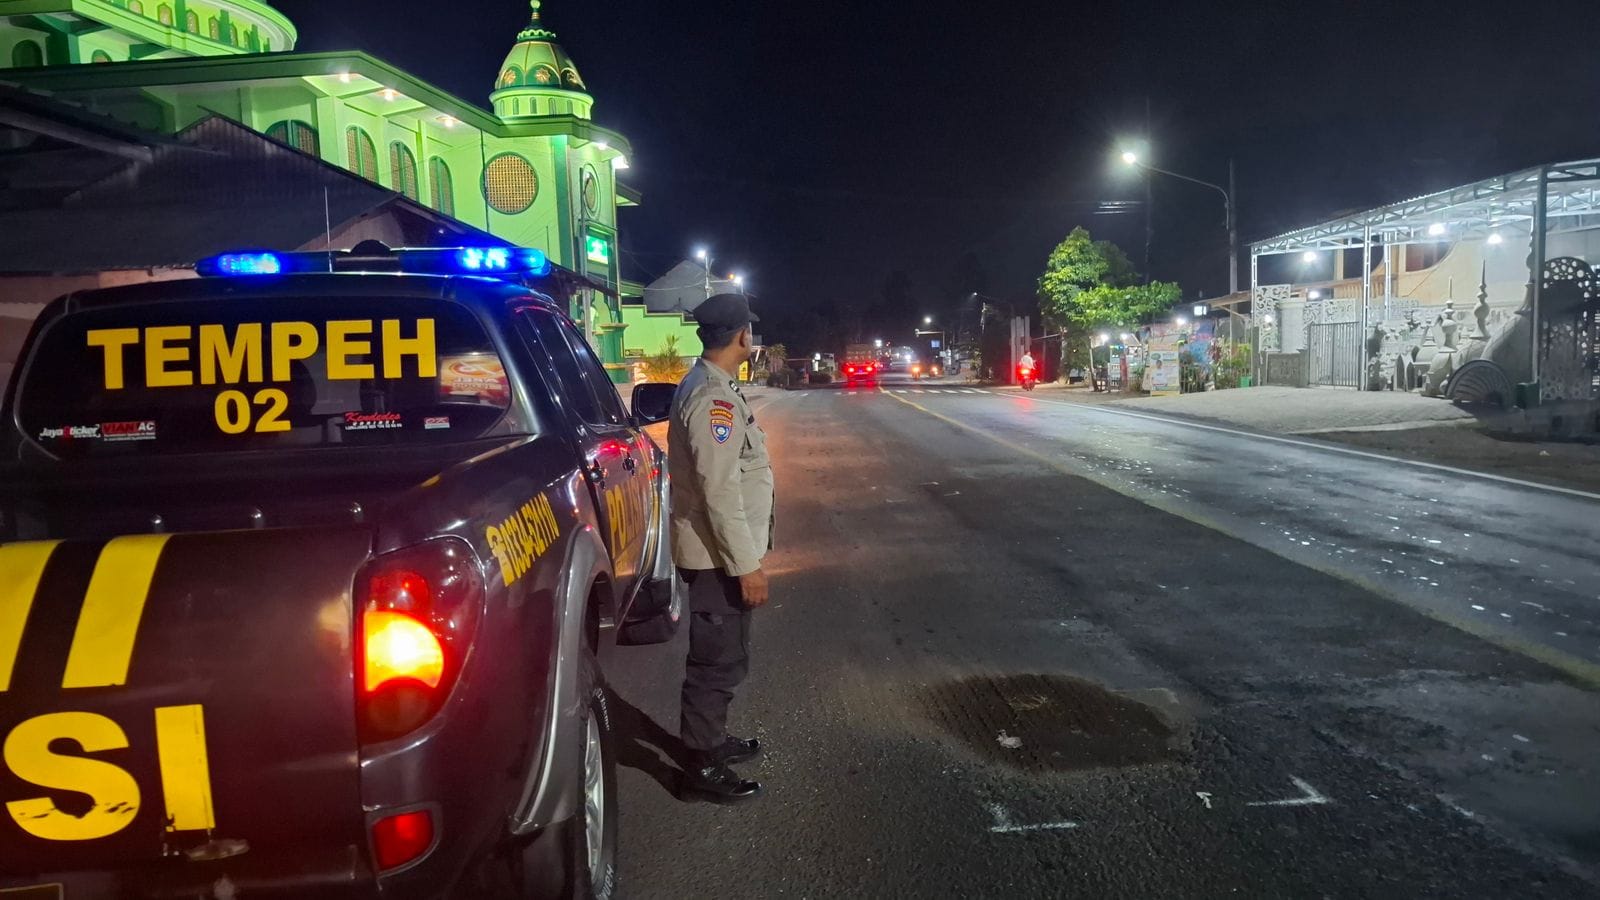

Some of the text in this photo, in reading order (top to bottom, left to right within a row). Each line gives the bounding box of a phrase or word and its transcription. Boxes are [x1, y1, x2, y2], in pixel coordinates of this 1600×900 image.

[87, 318, 437, 390] TEMPEH
[138, 421, 155, 431] AC
[214, 388, 291, 434] 02
[4, 704, 215, 841] SI
